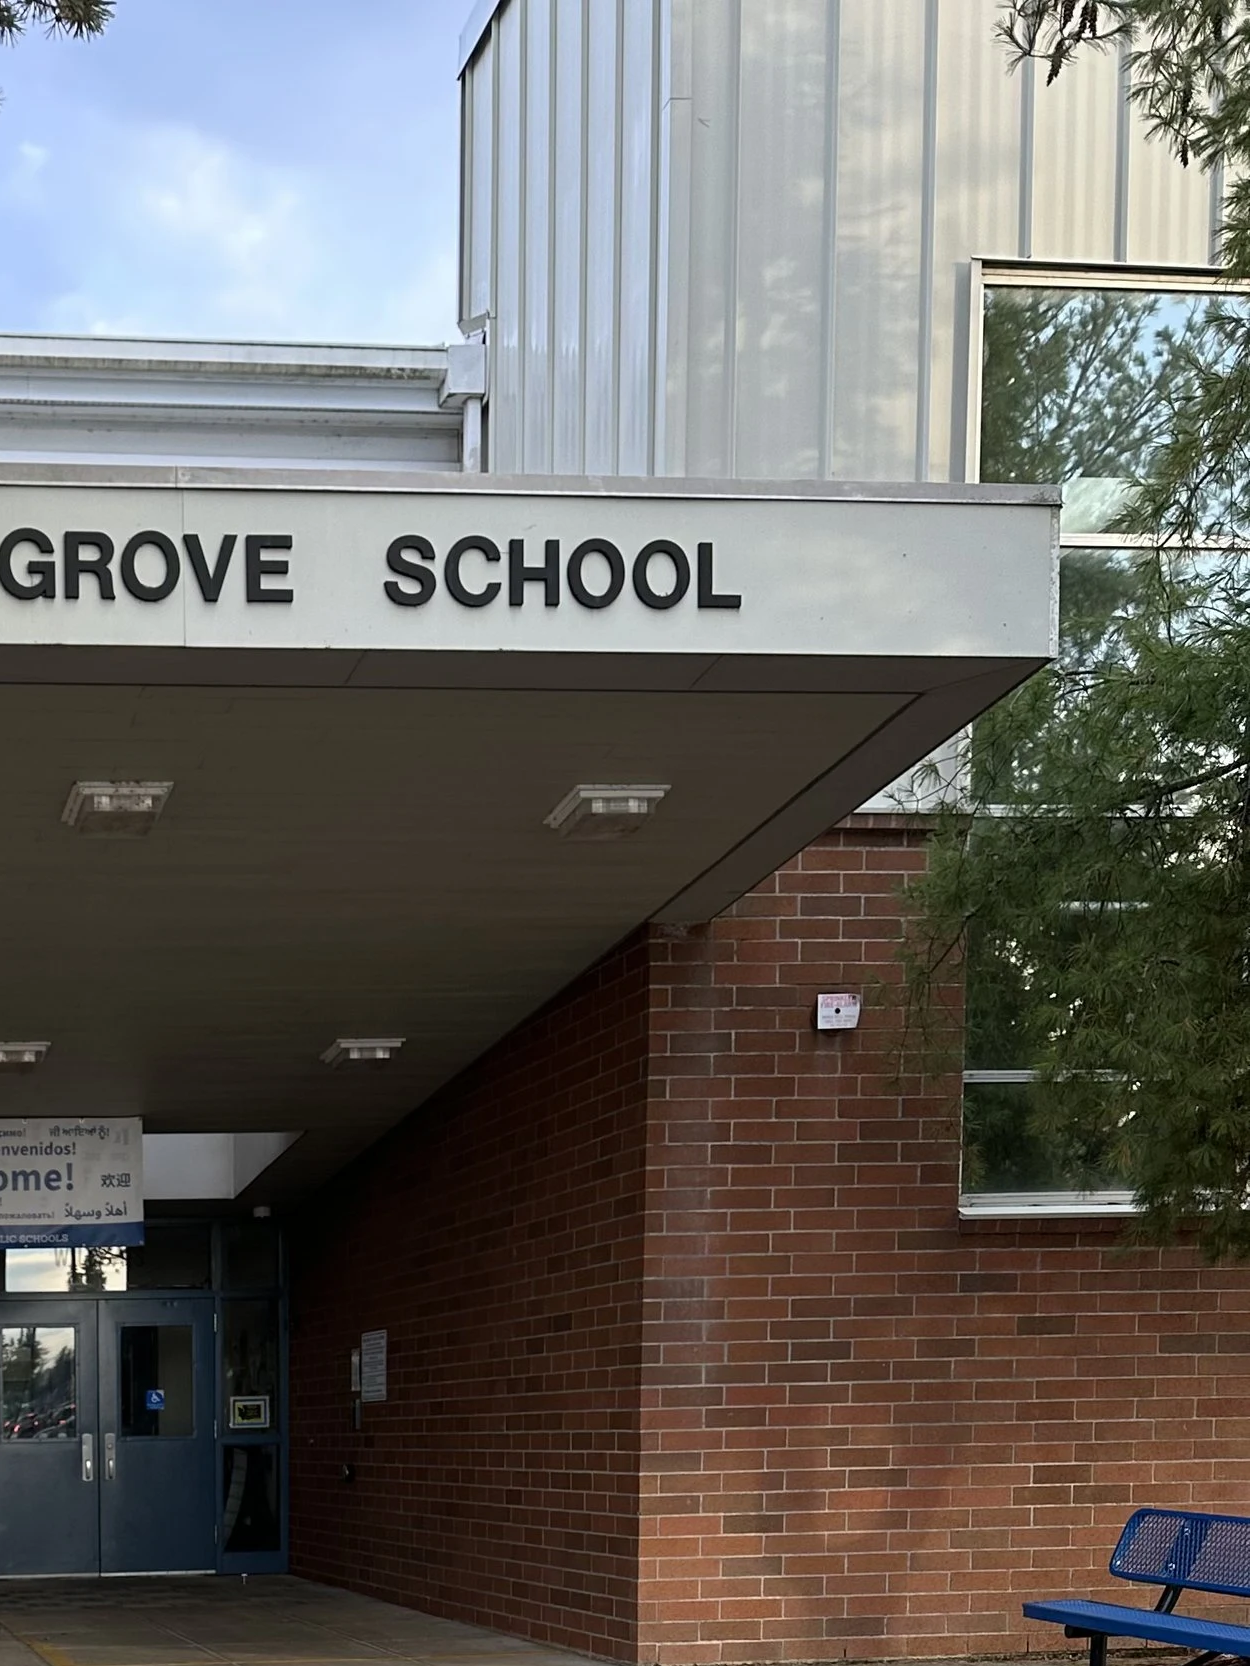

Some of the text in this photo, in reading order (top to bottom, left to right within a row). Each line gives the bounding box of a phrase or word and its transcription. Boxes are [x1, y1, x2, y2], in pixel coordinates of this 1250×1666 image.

[383, 534, 742, 611] SCHOOL
[101, 1173, 131, 1188] 欢迎
[19, 1233, 69, 1243] SCHOOLS
